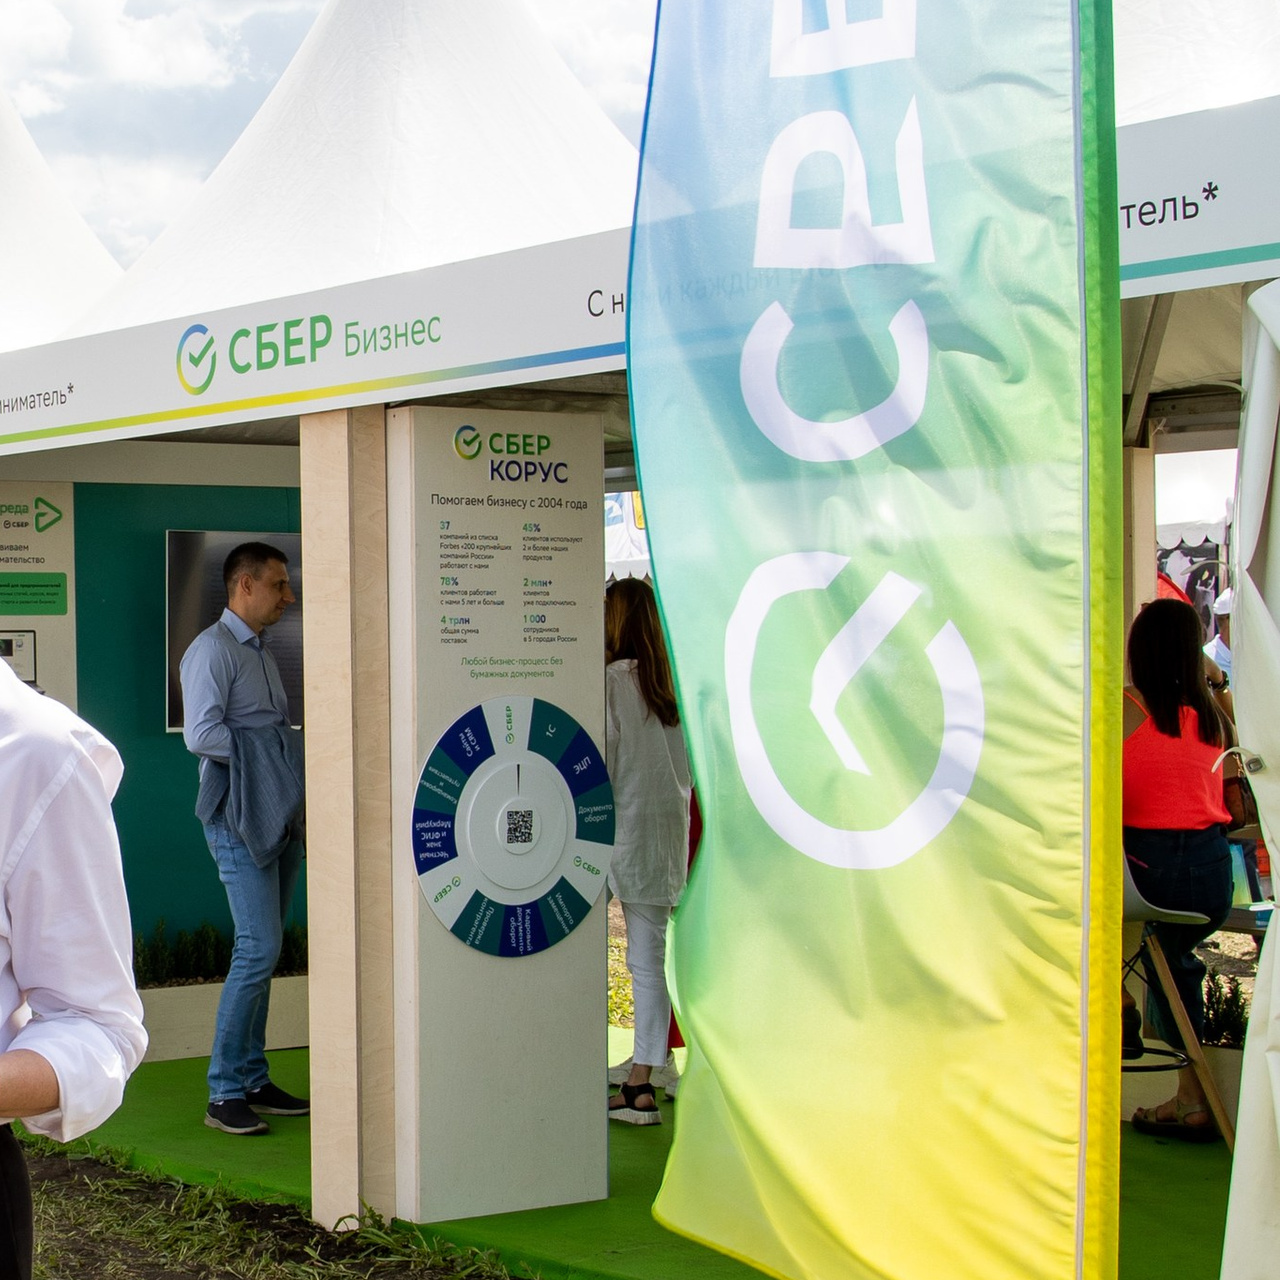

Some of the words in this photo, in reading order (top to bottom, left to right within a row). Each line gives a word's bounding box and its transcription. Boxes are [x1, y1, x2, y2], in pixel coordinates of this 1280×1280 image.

[228, 314, 333, 374] СБЕР
[345, 316, 441, 357] Бизнес
[488, 433, 551, 456] СБЕР
[490, 460, 569, 484] КОРУС
[431, 494, 484, 506] Помогаем
[487, 495, 526, 509] бизнесу
[530, 499, 536, 507] с
[538, 497, 563, 508] 2004
[565, 500, 588, 511] года
[440, 521, 450, 530] 37
[523, 523, 541, 532] 45%
[550, 536, 583, 544] используют
[476, 544, 512, 552] крупнейших
[532, 544, 550, 552] более
[440, 552, 470, 560] компаний
[522, 554, 552, 562] продуктов
[440, 562, 468, 570] работают
[440, 577, 458, 586] 78%
[523, 578, 528, 586] 2
[440, 616, 446, 624] 4
[448, 616, 470, 626] трлн
[460, 657, 487, 666] Любой
[489, 657, 548, 667] бизнес-процесс
[550, 656, 563, 666] без
[470, 670, 508, 680] бумажных
[510, 671, 554, 679] документов
[458, 732, 474, 758] Сайты
[573, 756, 592, 775] ЭЦП
[584, 814, 608, 824] оборот
[416, 821, 451, 830] Меркурий
[420, 852, 449, 860] Честный
[582, 862, 600, 876] СБЕР
[434, 884, 452, 903] СБЕР
[555, 892, 574, 926] Импорто
[466, 898, 488, 946] контрагента
[474, 906, 494, 945] Проверка
[526, 908, 534, 952] Кадровый
